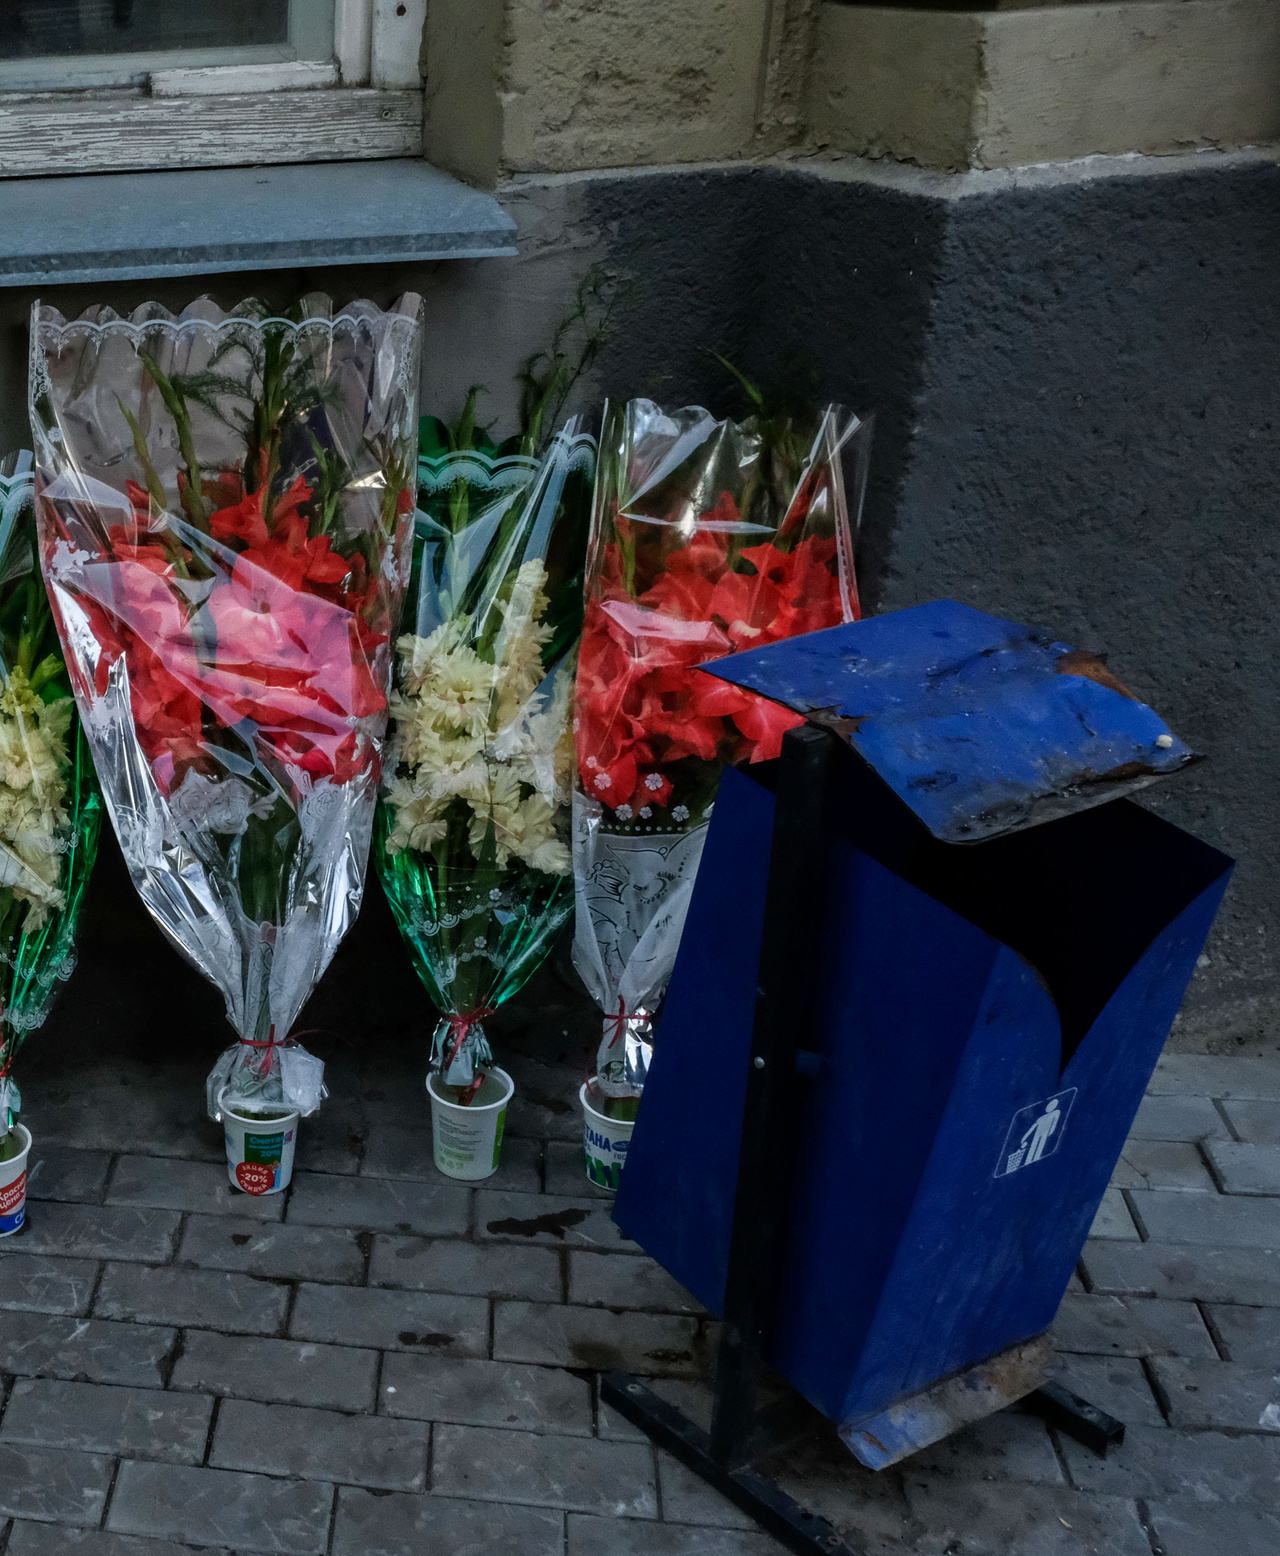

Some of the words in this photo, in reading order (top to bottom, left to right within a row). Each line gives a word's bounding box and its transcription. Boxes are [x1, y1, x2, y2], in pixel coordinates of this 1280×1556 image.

[242, 1164, 268, 1175] АКЦИЯ
[241, 1173, 268, 1183] -20%
[240, 1180, 267, 1192] СКИДКА
[0, 1192, 20, 1210] цена
